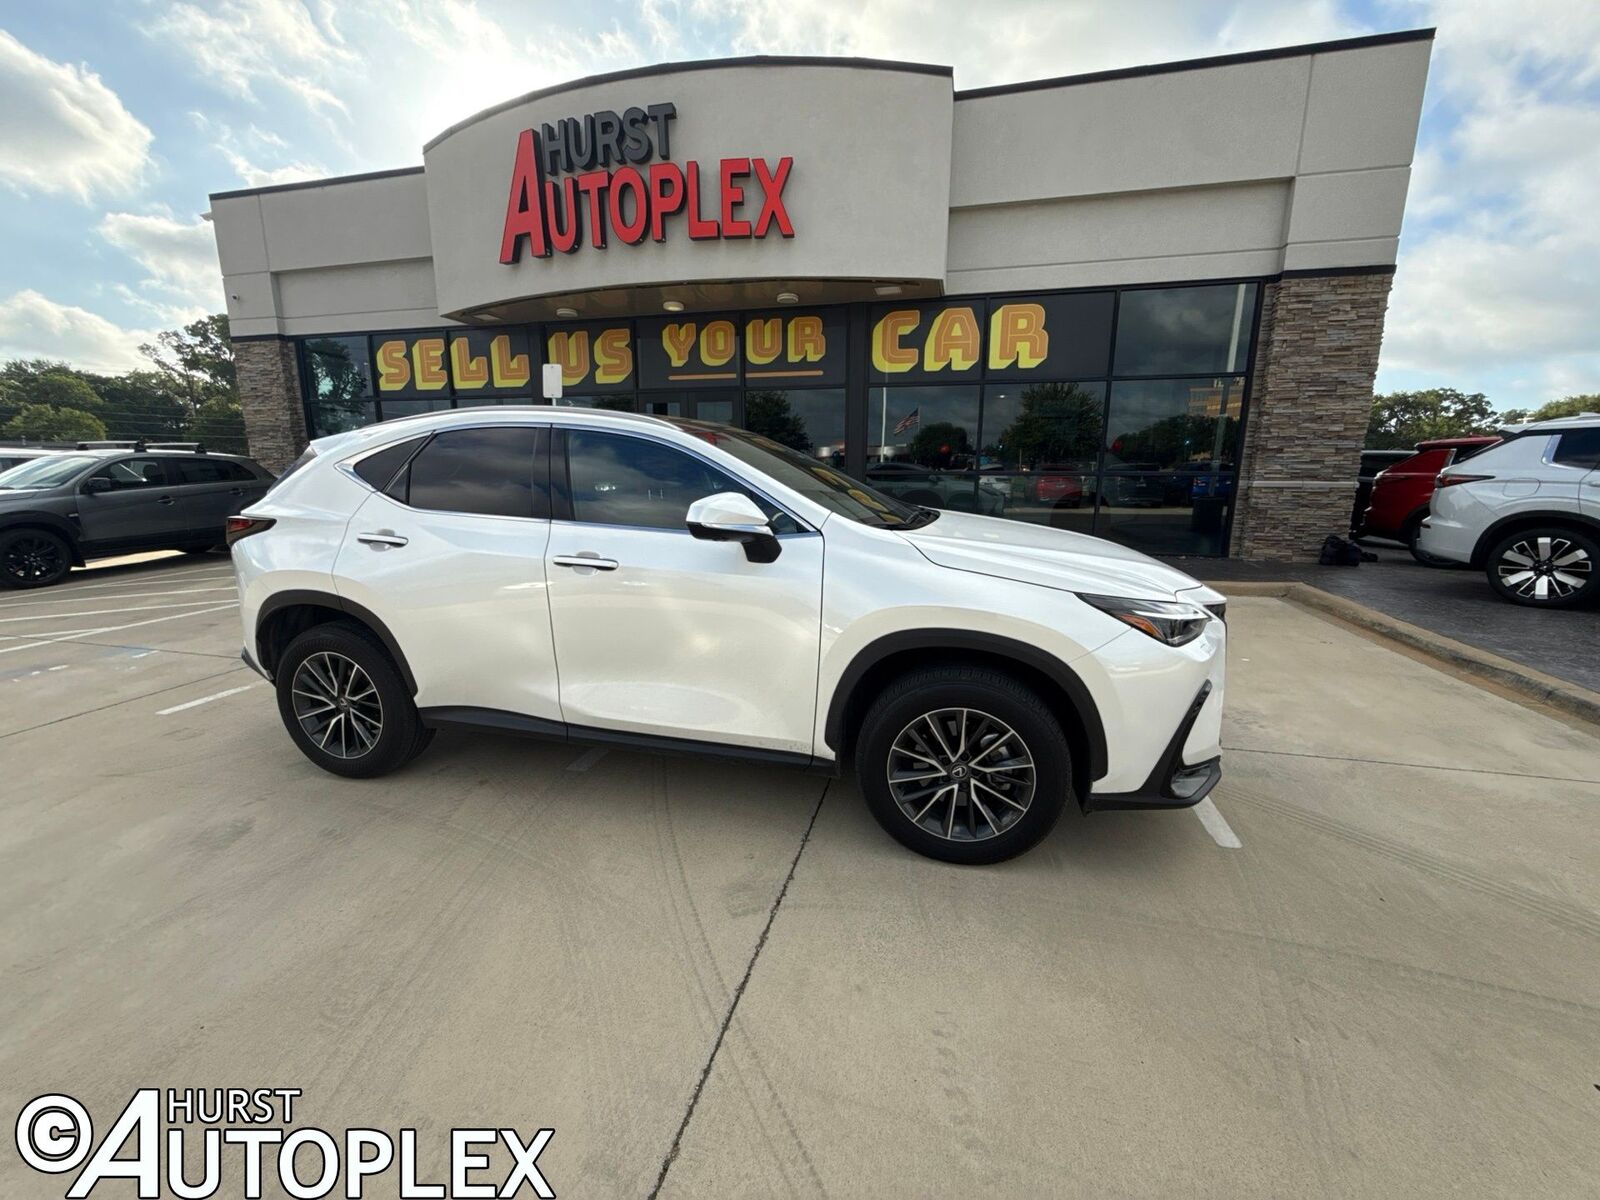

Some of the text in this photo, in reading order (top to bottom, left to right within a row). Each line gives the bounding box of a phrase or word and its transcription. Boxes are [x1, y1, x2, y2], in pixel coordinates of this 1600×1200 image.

[541, 102, 676, 176] HURST
[499, 128, 795, 265] AUTOPLEX
[376, 303, 1049, 391] SELL US YOUR CAR
